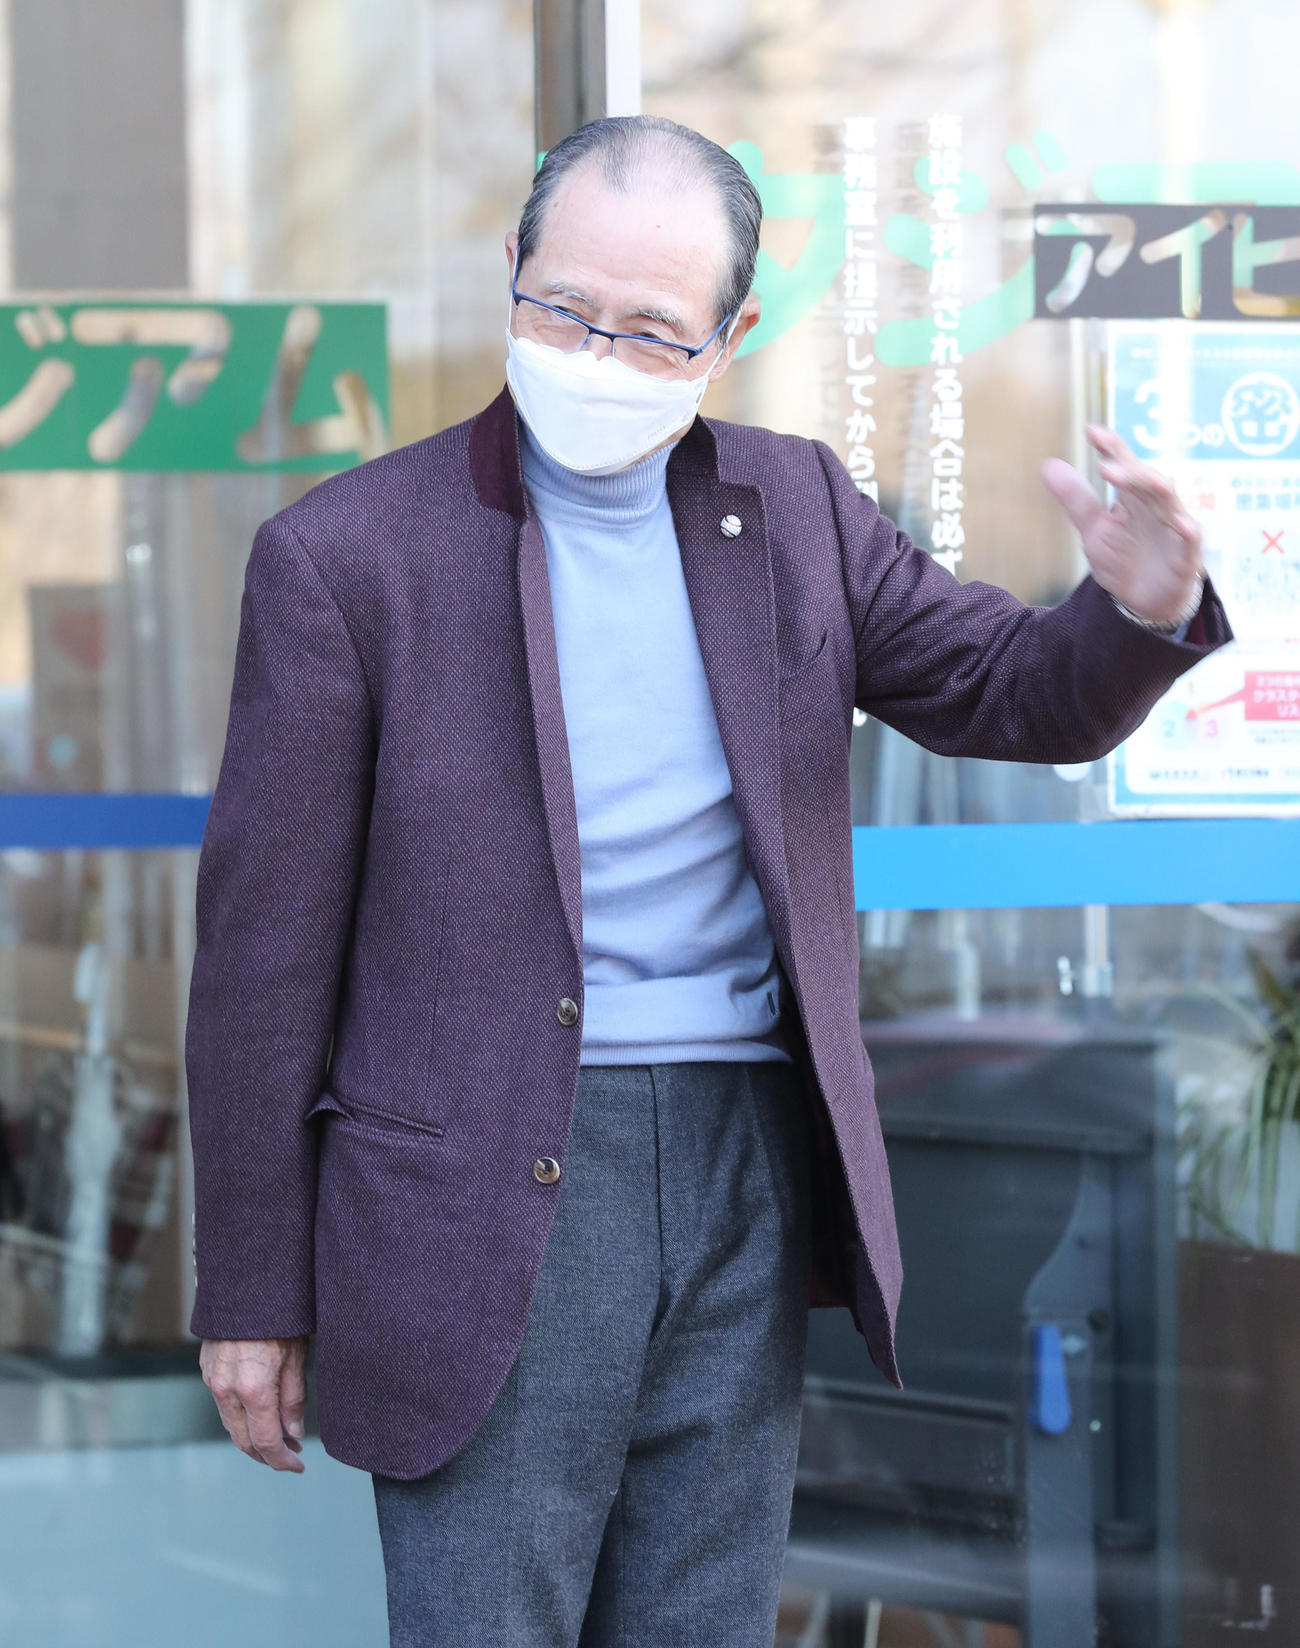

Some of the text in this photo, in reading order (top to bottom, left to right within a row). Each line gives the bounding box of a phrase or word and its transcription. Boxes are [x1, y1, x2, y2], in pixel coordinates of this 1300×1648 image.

[843, 116, 879, 503] 事務室に提示してから
